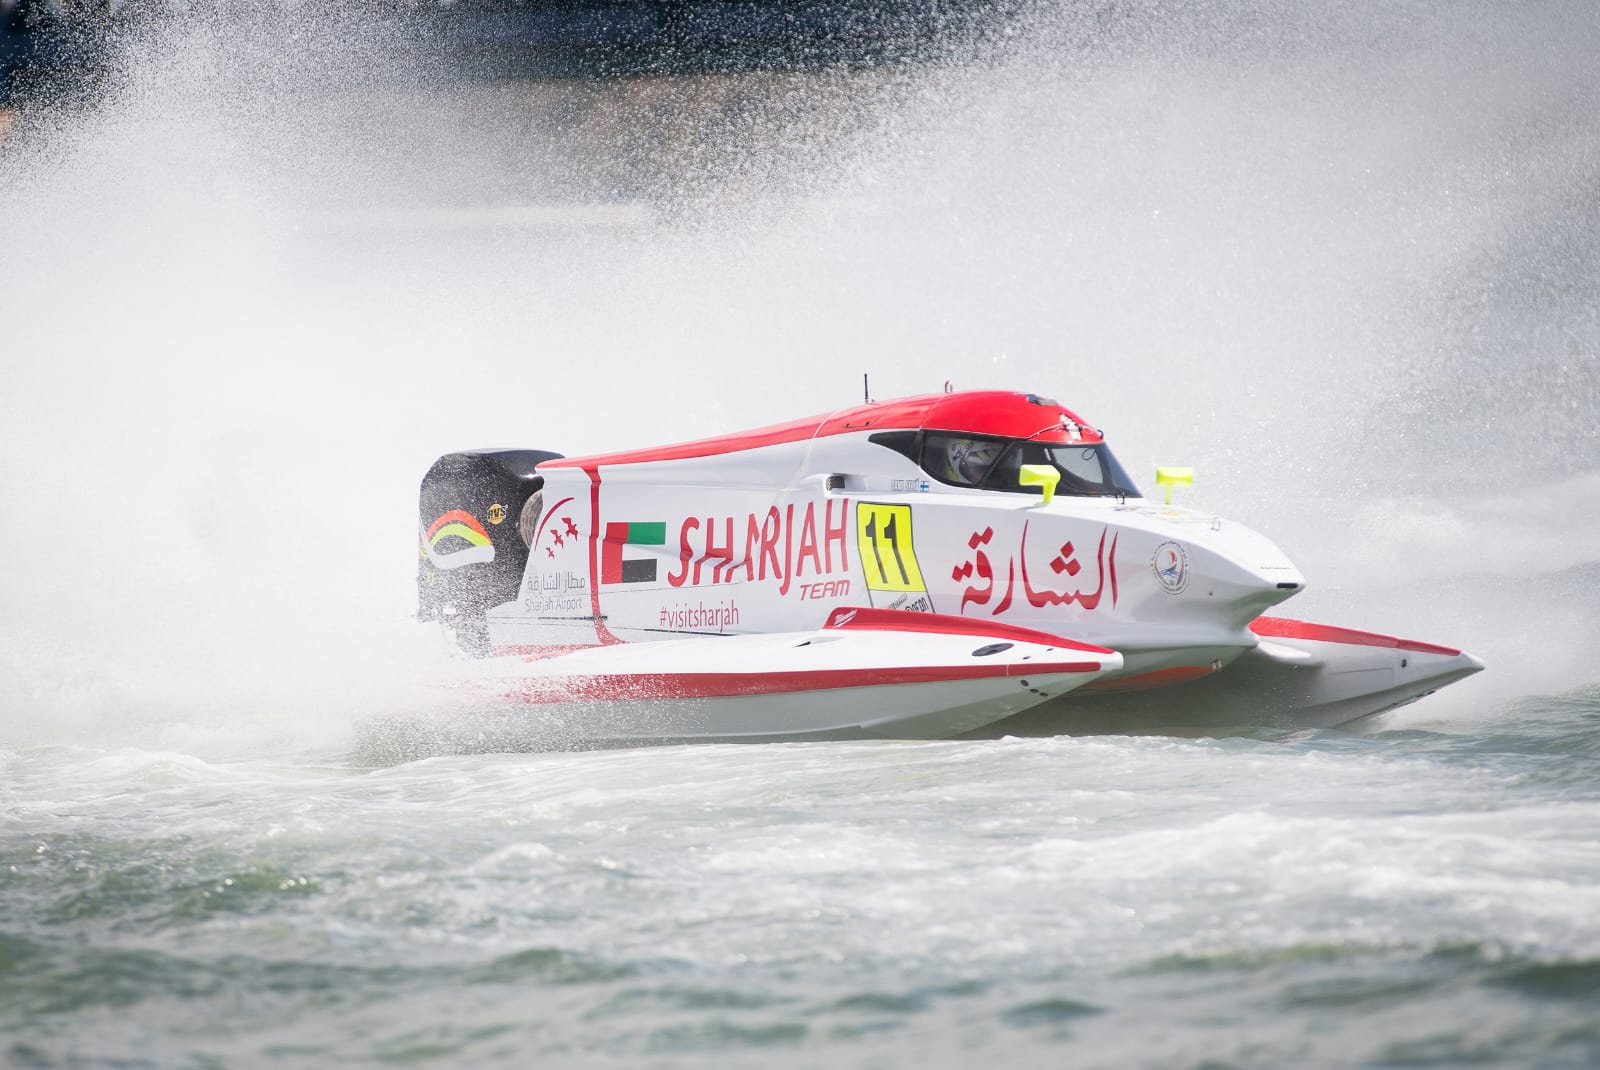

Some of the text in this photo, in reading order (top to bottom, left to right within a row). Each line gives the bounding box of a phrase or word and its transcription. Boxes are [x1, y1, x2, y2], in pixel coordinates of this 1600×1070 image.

[667, 498, 849, 596] SHARJAH
[865, 511, 911, 585] 11
[952, 519, 1119, 615] الشارقة
[525, 597, 583, 614] Sharjah Airport
[659, 600, 740, 633] #visitsharjah
[799, 580, 850, 601] TEAM
